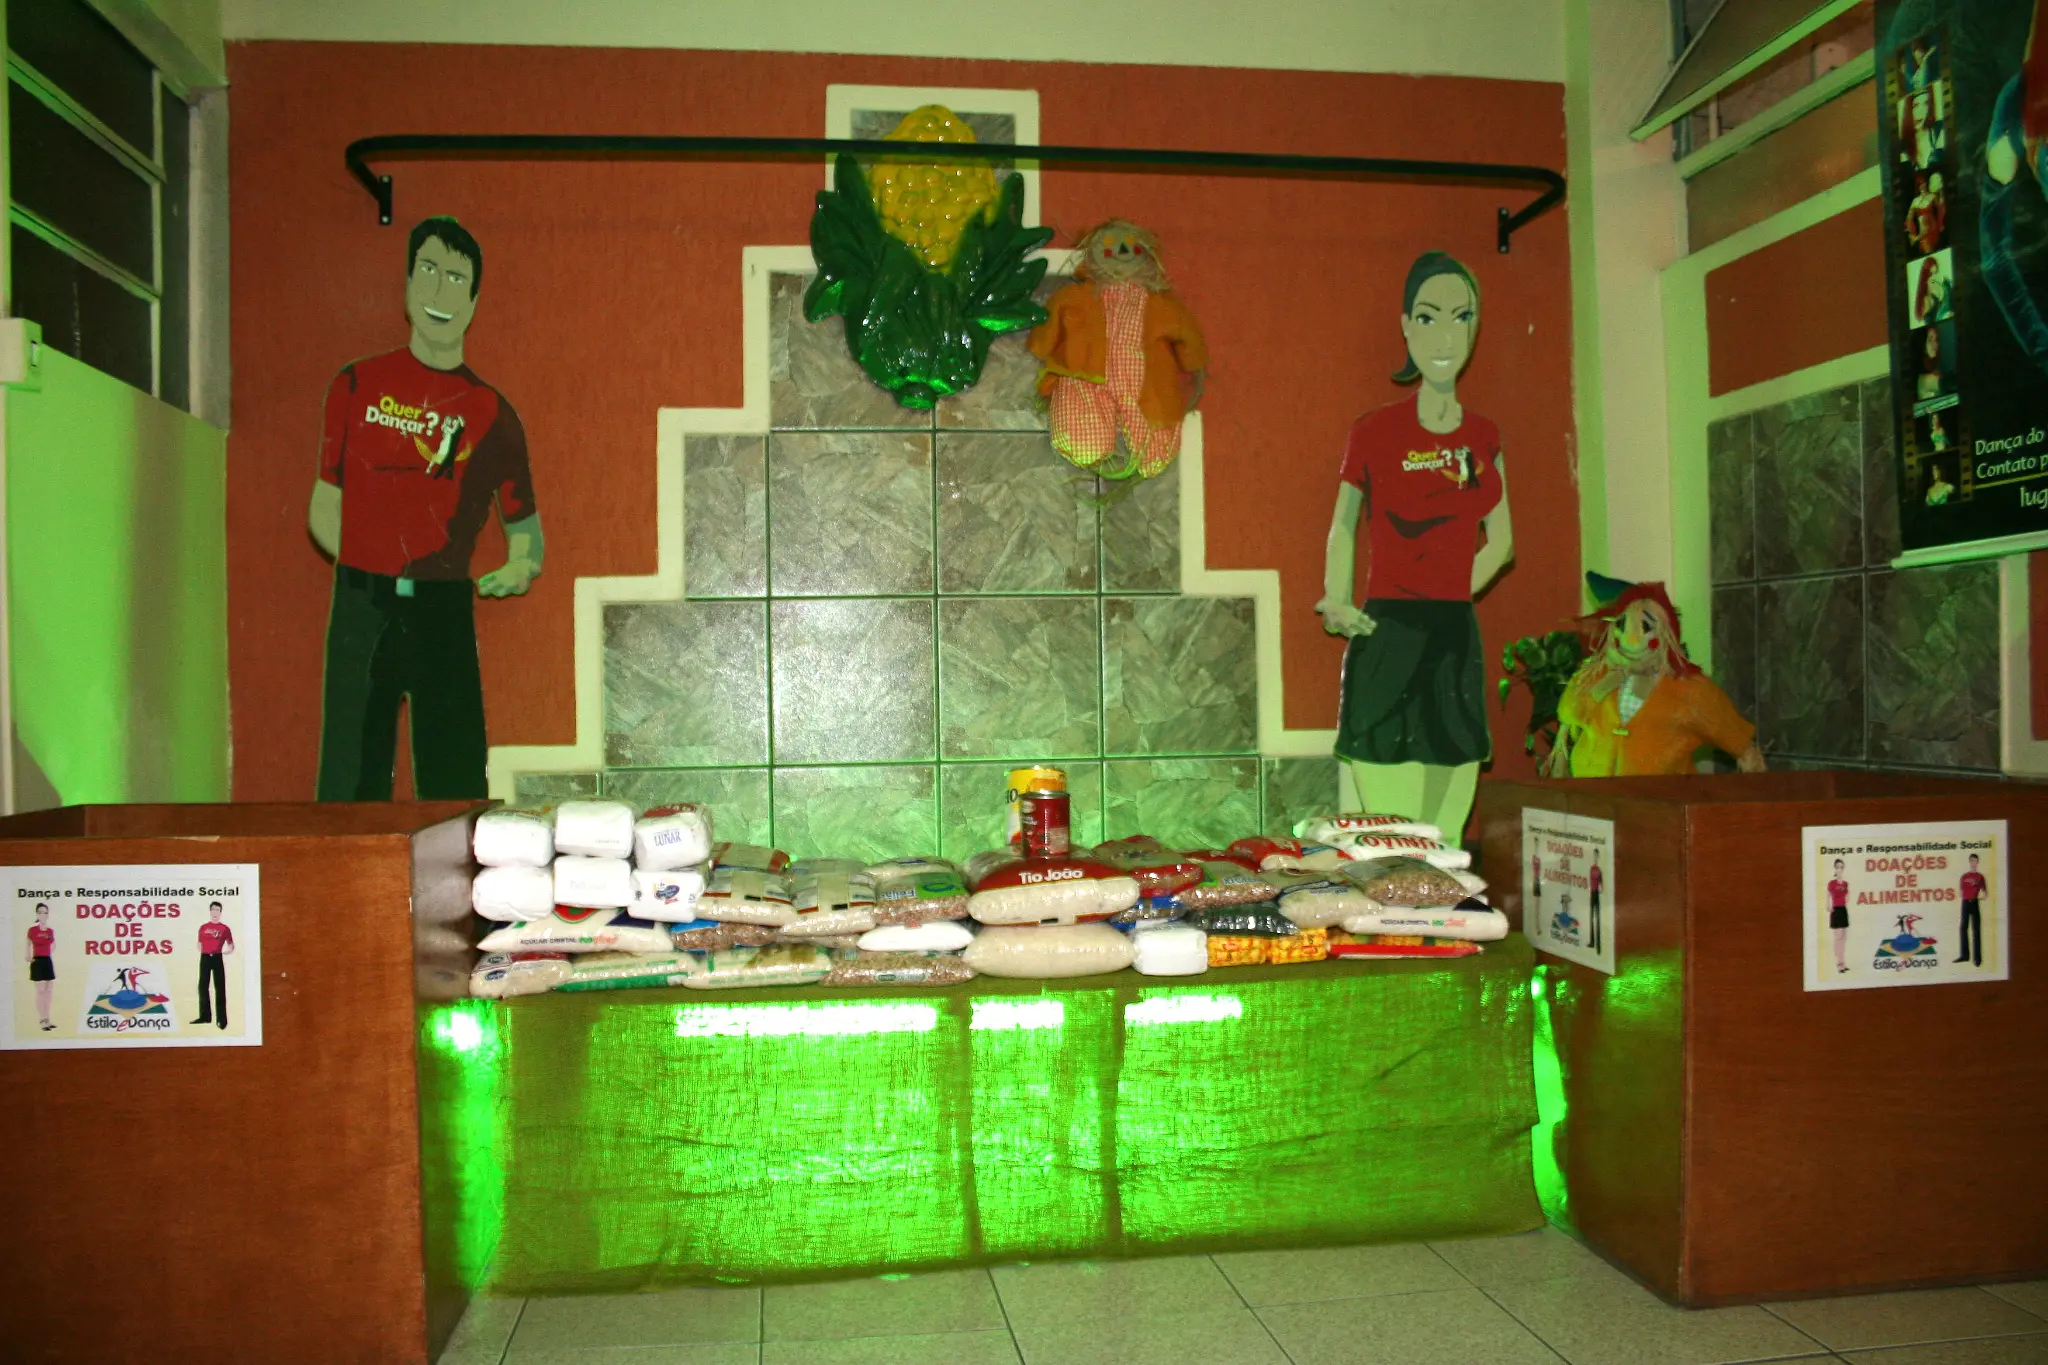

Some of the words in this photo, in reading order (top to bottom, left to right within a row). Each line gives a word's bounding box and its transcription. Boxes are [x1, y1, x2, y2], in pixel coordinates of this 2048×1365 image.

[380, 396, 422, 420] Quer
[1975, 435, 2023, 455] Dança
[2025, 427, 2044, 445] do
[1976, 456, 2037, 479] Contato
[653, 829, 682, 847] LUNAR
[1820, 846, 1853, 855] Dança
[1866, 841, 1957, 855] Responsabilidade
[1960, 840, 1992, 850] Social
[1865, 855, 1948, 874] DOAÇÕES
[1019, 871, 1043, 885] Tio
[1044, 867, 1083, 882] João
[1895, 874, 1917, 888] DE
[18, 888, 60, 900] Dança
[65, 889, 72, 898] e
[77, 887, 194, 899] Responsabilidade
[199, 886, 239, 896] Social
[1856, 888, 1955, 905] ALIMENTOS
[76, 901, 181, 922] DOAÇÕES
[114, 923, 143, 937] DE
[85, 940, 173, 955] ROUPAS
